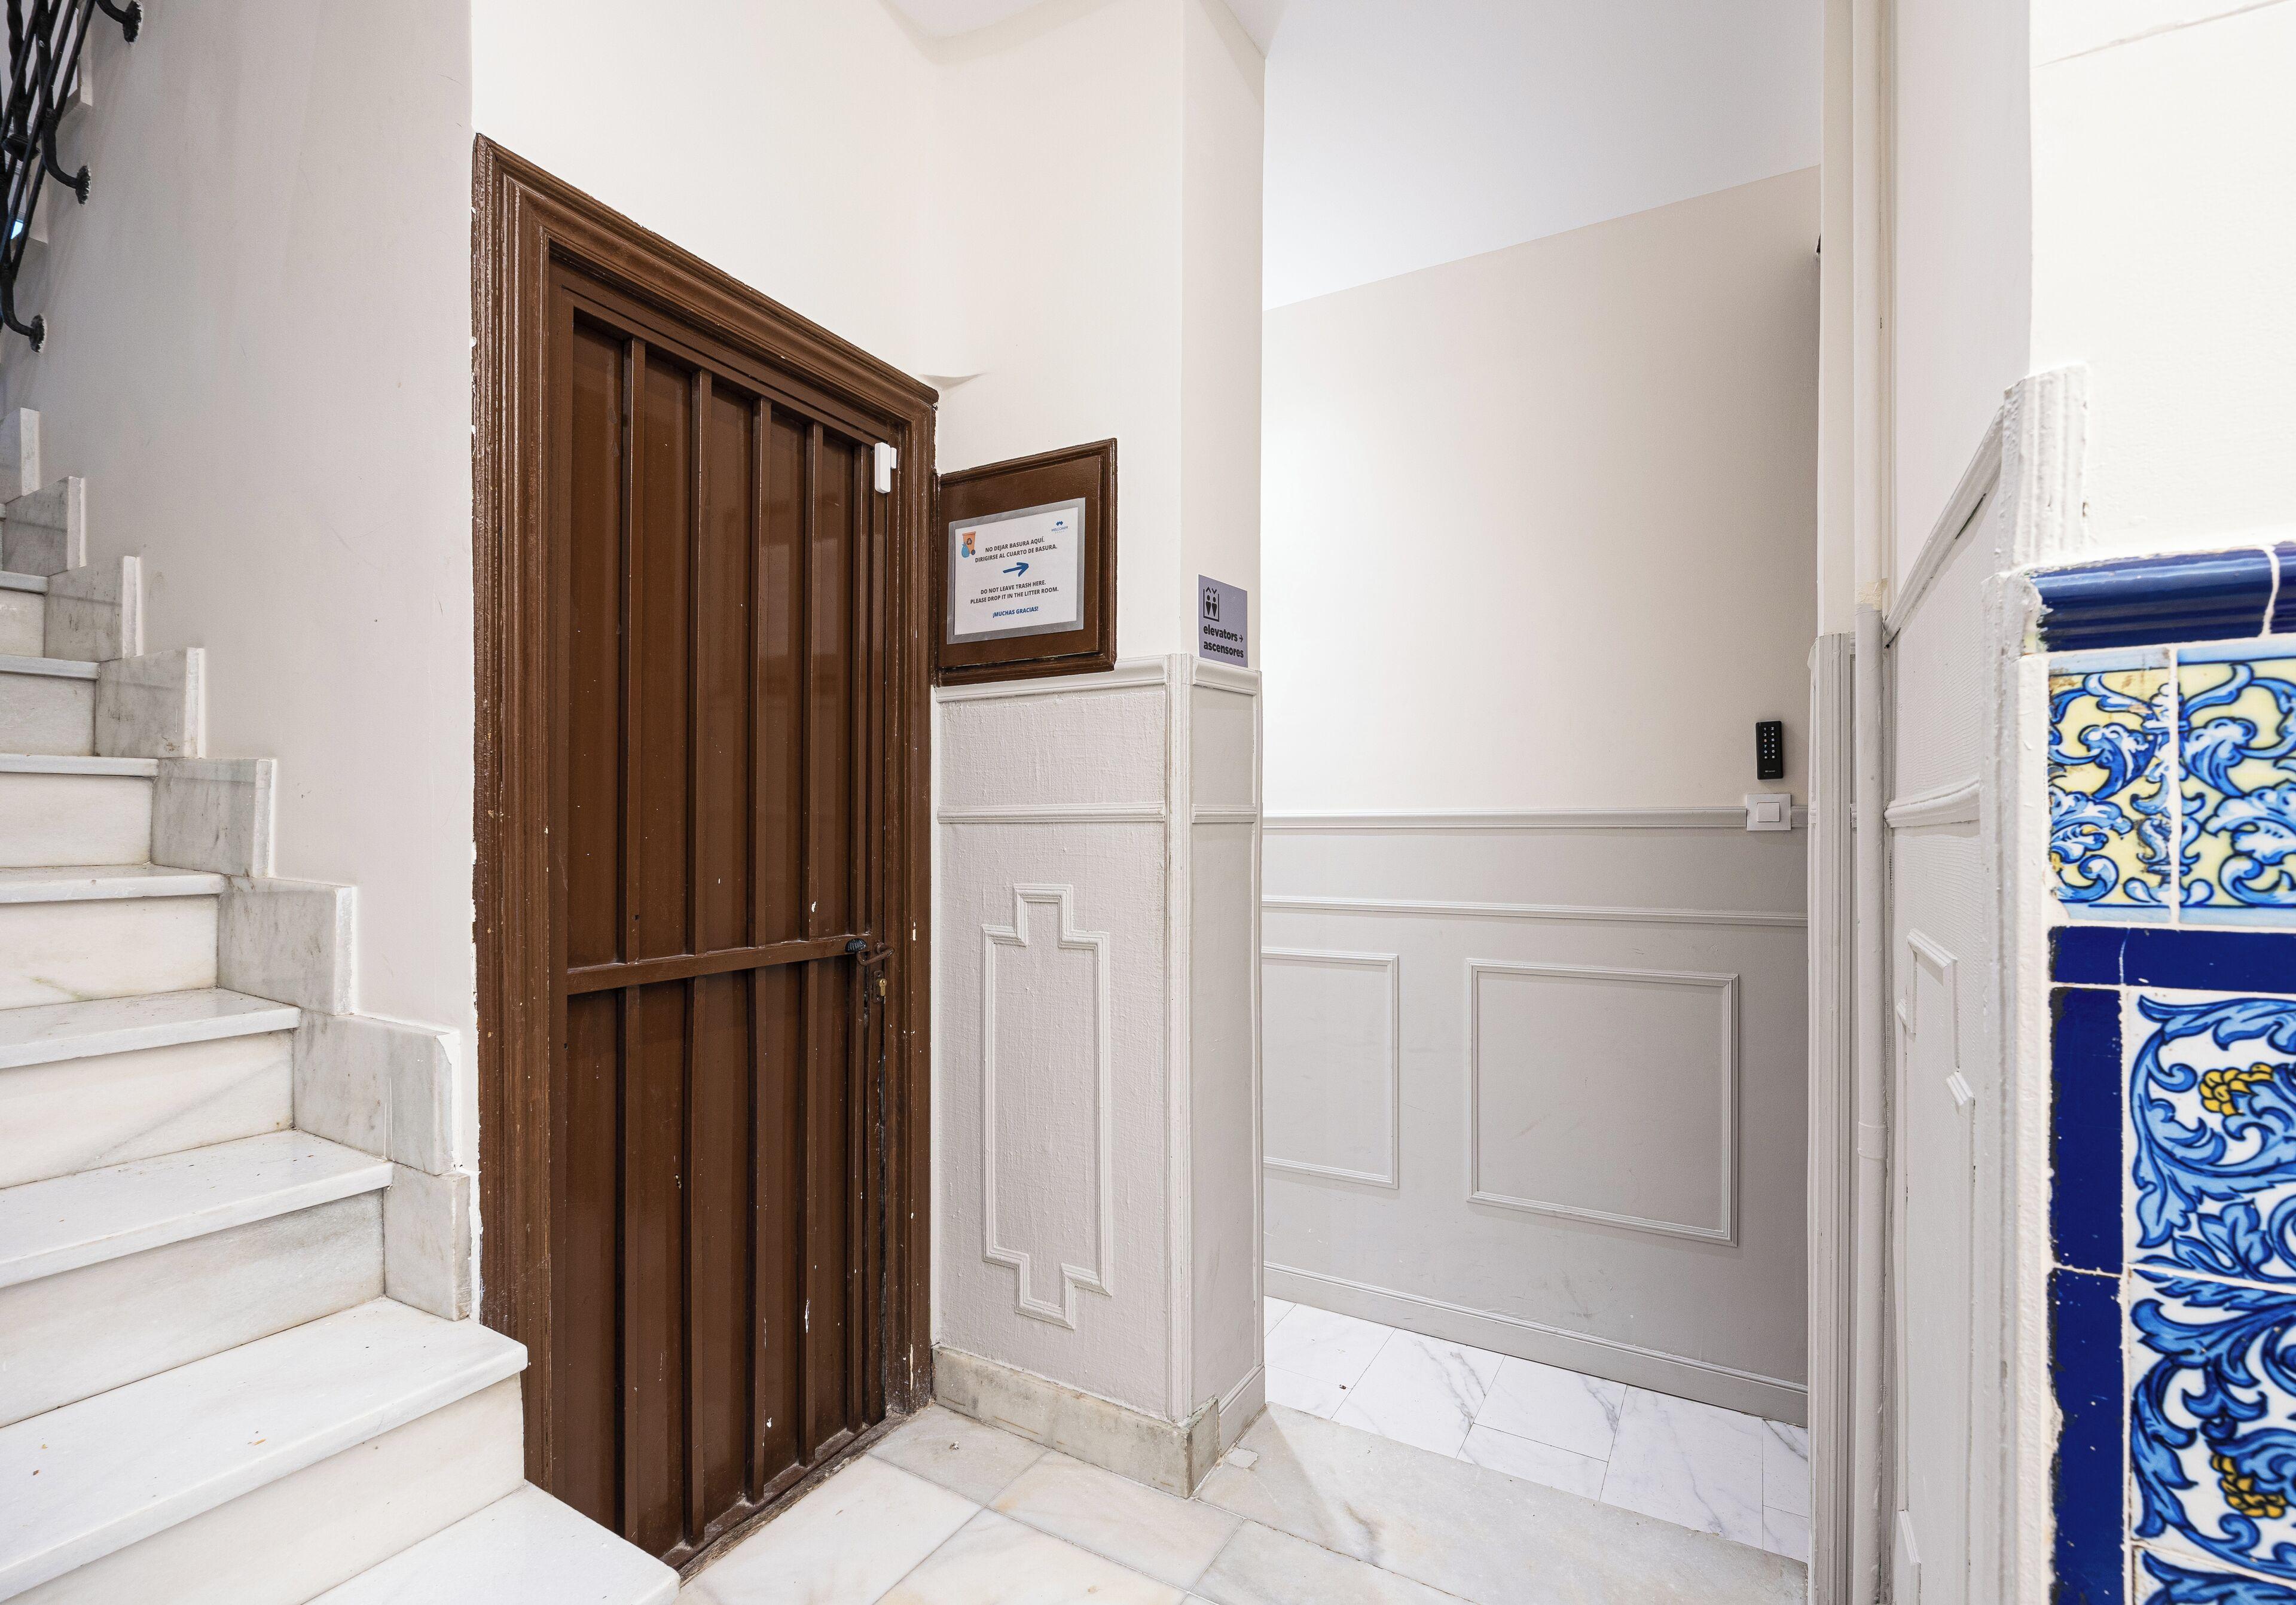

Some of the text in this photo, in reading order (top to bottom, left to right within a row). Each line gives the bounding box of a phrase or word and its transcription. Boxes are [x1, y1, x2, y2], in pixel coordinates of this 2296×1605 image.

[1030, 536, 1045, 545] AQUÍ.
[975, 554, 998, 563] DIRIGIRSE
[1035, 544, 1057, 553] BASURA.
[993, 609, 1015, 618] ¡MUCHAS
[1203, 624, 1238, 642] elevators
[1204, 640, 1244, 658] ascensores
